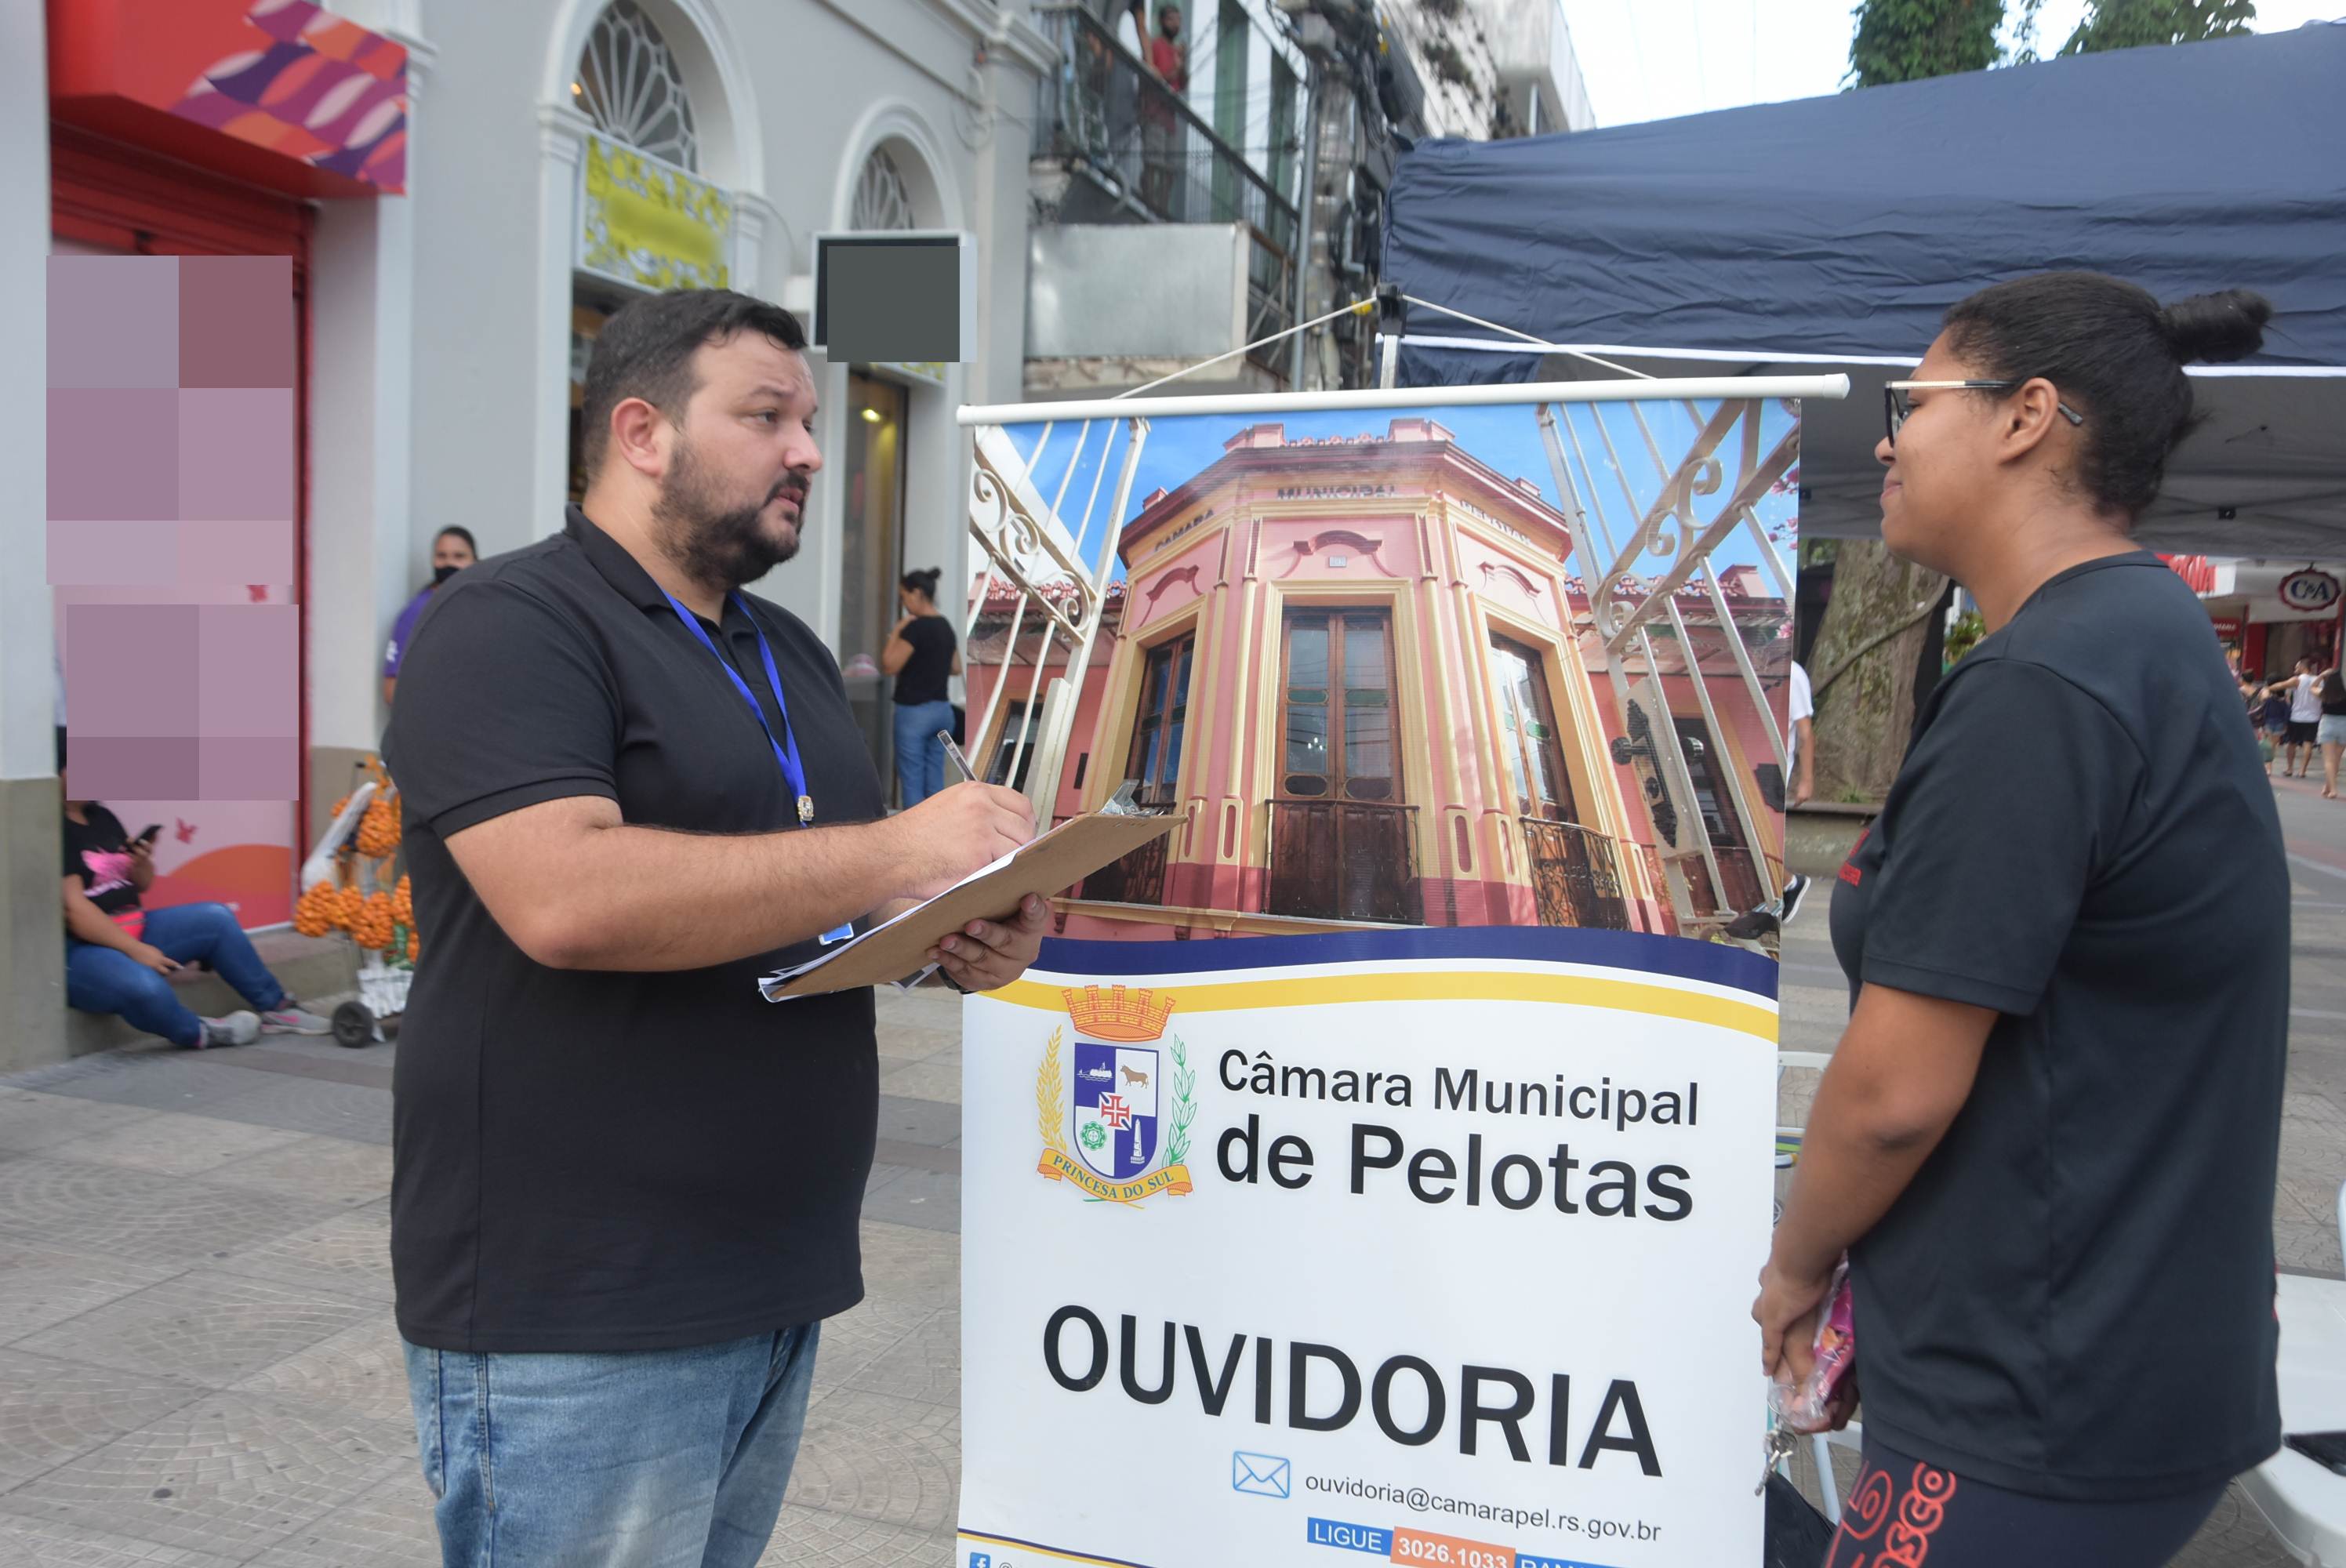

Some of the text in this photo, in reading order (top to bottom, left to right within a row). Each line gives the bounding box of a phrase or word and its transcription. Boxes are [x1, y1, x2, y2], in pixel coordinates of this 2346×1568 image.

[2290, 579, 2330, 601] C&A
[1220, 1049, 1698, 1131] Câmara Municipal
[1052, 1155, 1175, 1200] PRINCESA DO SUL
[1217, 1113, 1693, 1221] de Pelotas
[1044, 1305, 1663, 1477] OUVIDORIA
[1306, 1475, 1661, 1541] ouvidoria@camarapel.rs.gov.br
[1313, 1523, 1508, 1568] LIGUE 3026.1033
